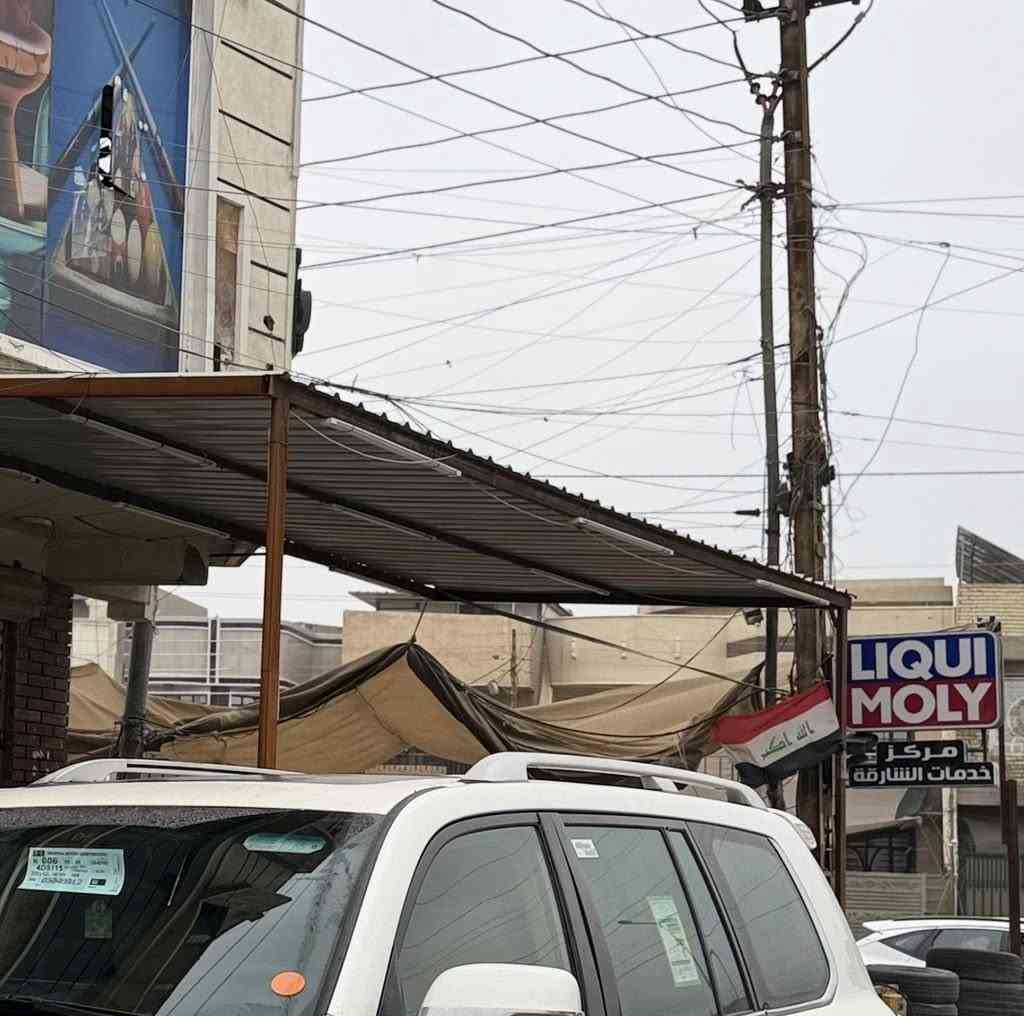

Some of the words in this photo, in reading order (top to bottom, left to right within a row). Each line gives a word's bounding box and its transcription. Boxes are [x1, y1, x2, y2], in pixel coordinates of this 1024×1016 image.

[850, 637, 987, 680] LIQUI
[851, 682, 993, 725] MOLY
[885, 744, 958, 762] مركز
[853, 767, 923, 785] الشارقة
[927, 766, 992, 781] خدمات
